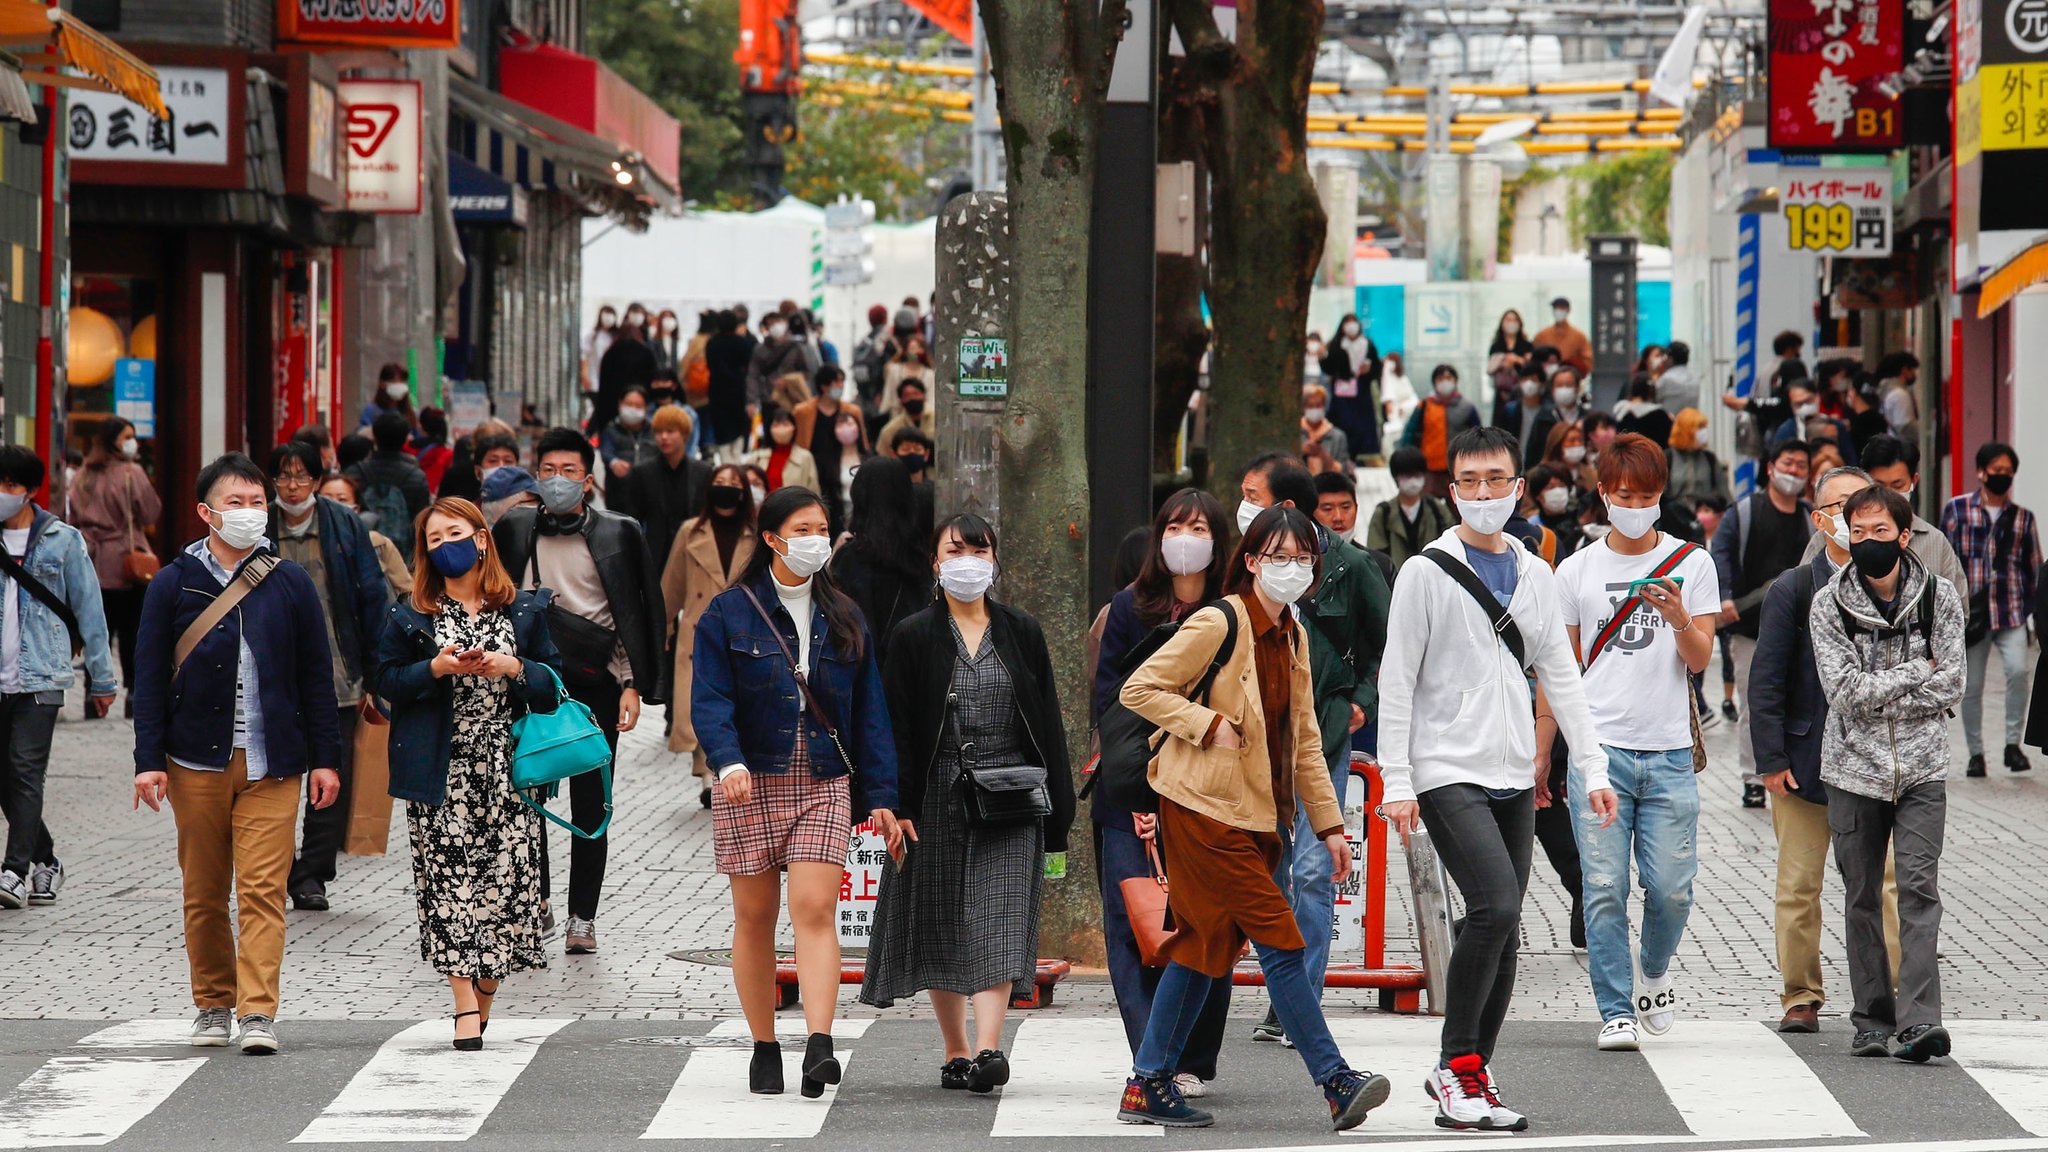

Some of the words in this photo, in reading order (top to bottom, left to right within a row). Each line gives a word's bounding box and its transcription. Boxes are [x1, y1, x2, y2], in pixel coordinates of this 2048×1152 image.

[1857, 0, 1880, 45] 酒屋
[1856, 108, 1894, 137] B1
[1787, 180, 1882, 199] ハイボール
[961, 345, 982, 354] FREE
[1597, 612, 1668, 631] BERRY
[840, 910, 877, 922] 新宿
